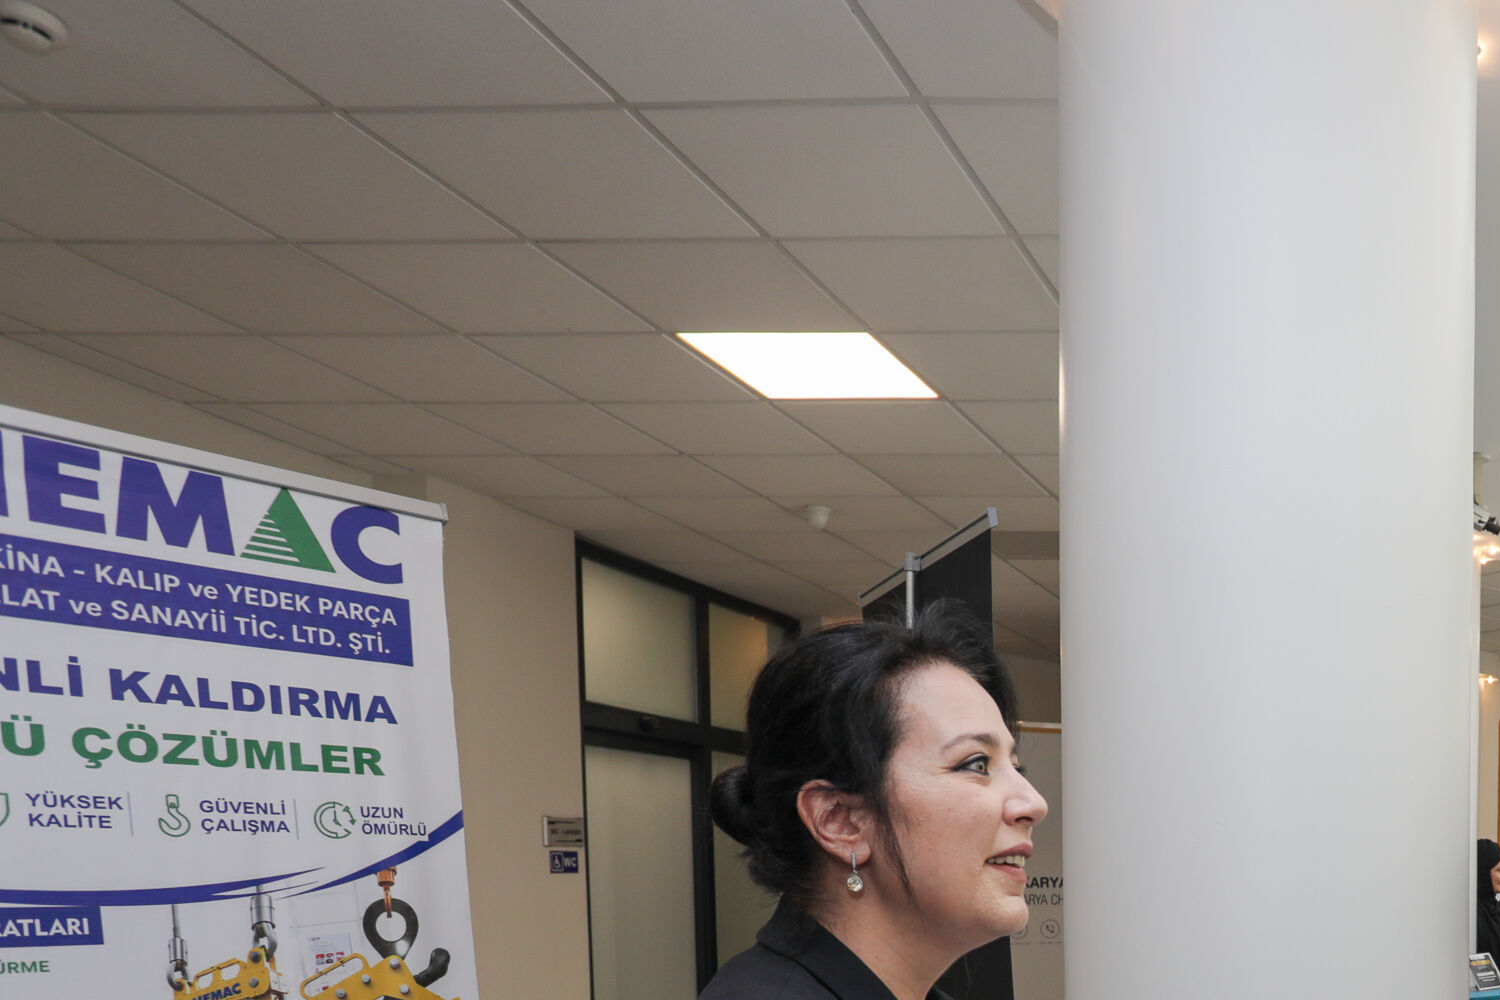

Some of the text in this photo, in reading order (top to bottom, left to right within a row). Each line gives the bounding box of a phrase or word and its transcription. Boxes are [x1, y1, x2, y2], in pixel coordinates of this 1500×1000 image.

[0, 429, 404, 585] EMAC
[95, 563, 181, 593] KALIP
[188, 585, 218, 600] ve
[225, 583, 312, 614] YEDEK
[319, 598, 398, 628] PARÇA
[1, 584, 391, 656] LAT ve SANAYİİ TİC. LTD. ŞTİ.
[109, 668, 398, 724] KALDIRMA
[71, 723, 386, 777] ÇÖZÜMLER
[25, 791, 124, 810] YÜKSEK
[199, 799, 286, 816] GÜVENLİ
[28, 811, 113, 829] KALİTE
[360, 807, 404, 819] UZUN
[201, 818, 290, 836] ÇALIŞMA
[362, 821, 427, 837] ÖMÜRLÜ
[0, 917, 90, 937] ATLARI
